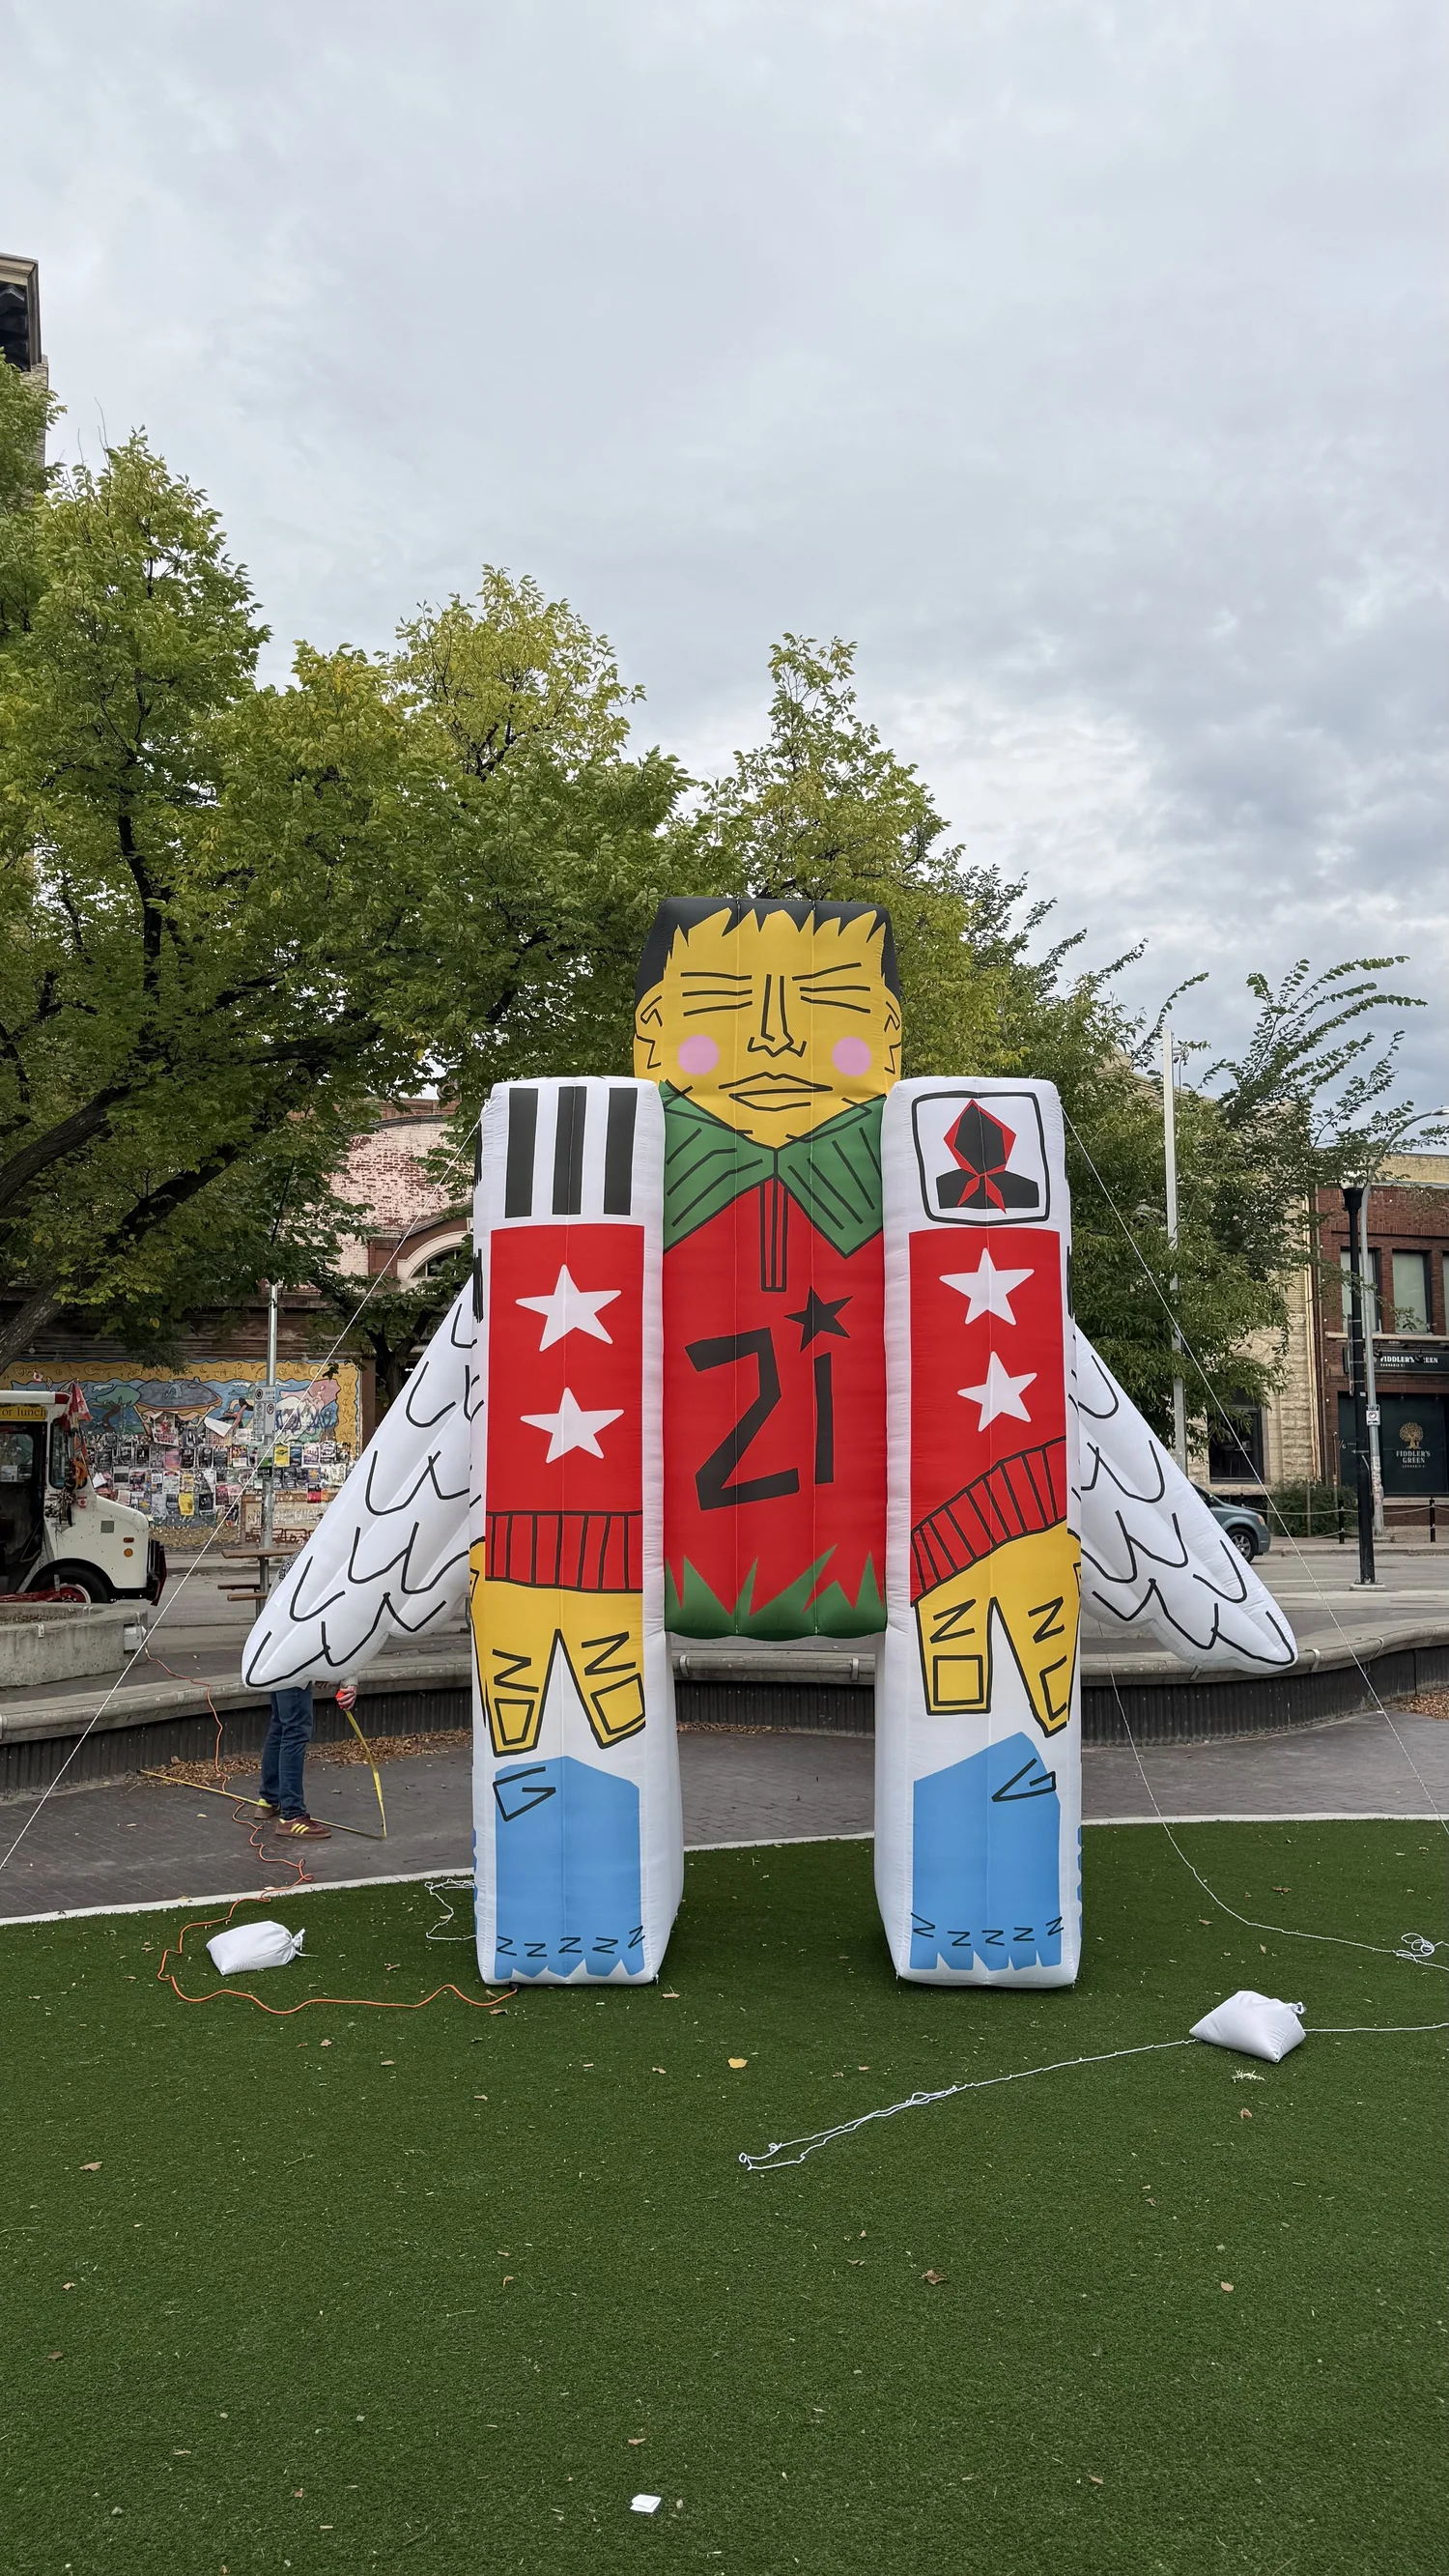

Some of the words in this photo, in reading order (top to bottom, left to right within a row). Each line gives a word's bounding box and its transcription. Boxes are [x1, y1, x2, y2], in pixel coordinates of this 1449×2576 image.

[0, 1407, 14, 1417] or
[17, 1406, 46, 1417] lunch
[684, 1327, 834, 1511] 21
